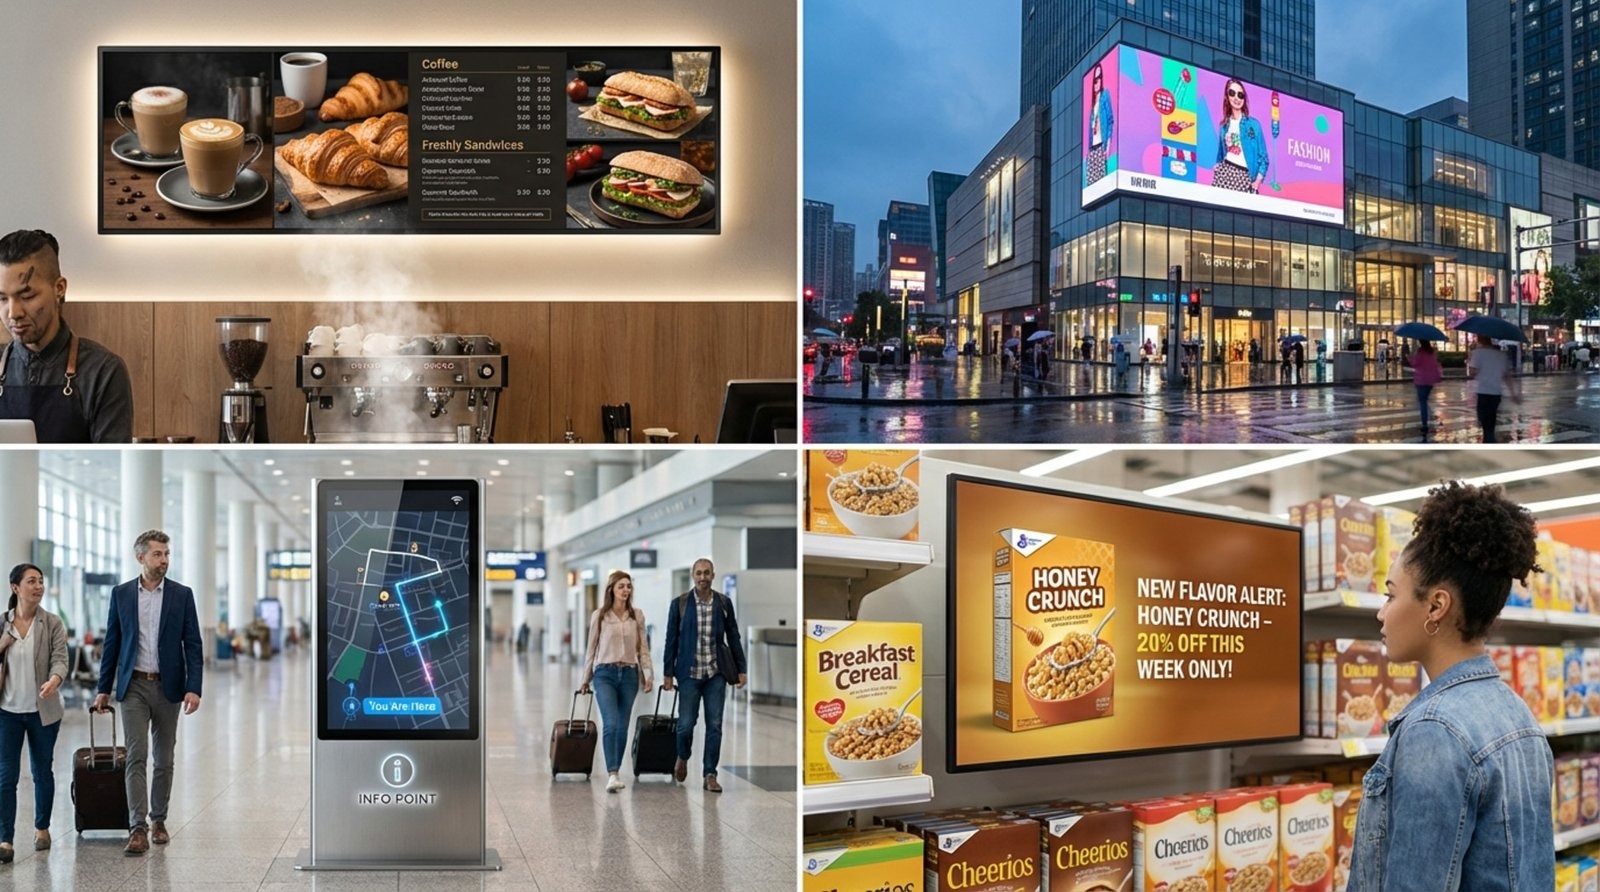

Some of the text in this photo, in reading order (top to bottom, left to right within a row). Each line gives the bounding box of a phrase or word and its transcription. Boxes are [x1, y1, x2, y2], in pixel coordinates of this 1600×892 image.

[422, 58, 459, 70] Coffee
[422, 139, 462, 153] Freshly
[1287, 138, 1331, 164] FASHION
[1033, 567, 1099, 589] HONEY
[1027, 587, 1104, 611] CRUNCH
[1137, 577, 1287, 607] NEW FLAVOR ALERT:
[1137, 605, 1194, 626] HONEY
[1197, 608, 1260, 629] CRUNCH
[1137, 632, 1245, 654] 20% OFF THIS
[818, 643, 916, 673] Breakfast
[1137, 659, 1234, 680] WEEK ONLY!
[835, 662, 898, 691] Cereal
[368, 700, 388, 711] You
[391, 701, 408, 711] Are
[359, 793, 437, 805] INFO POINT
[1056, 839, 1128, 870] Cheerios
[946, 853, 1034, 890] Cheerios
